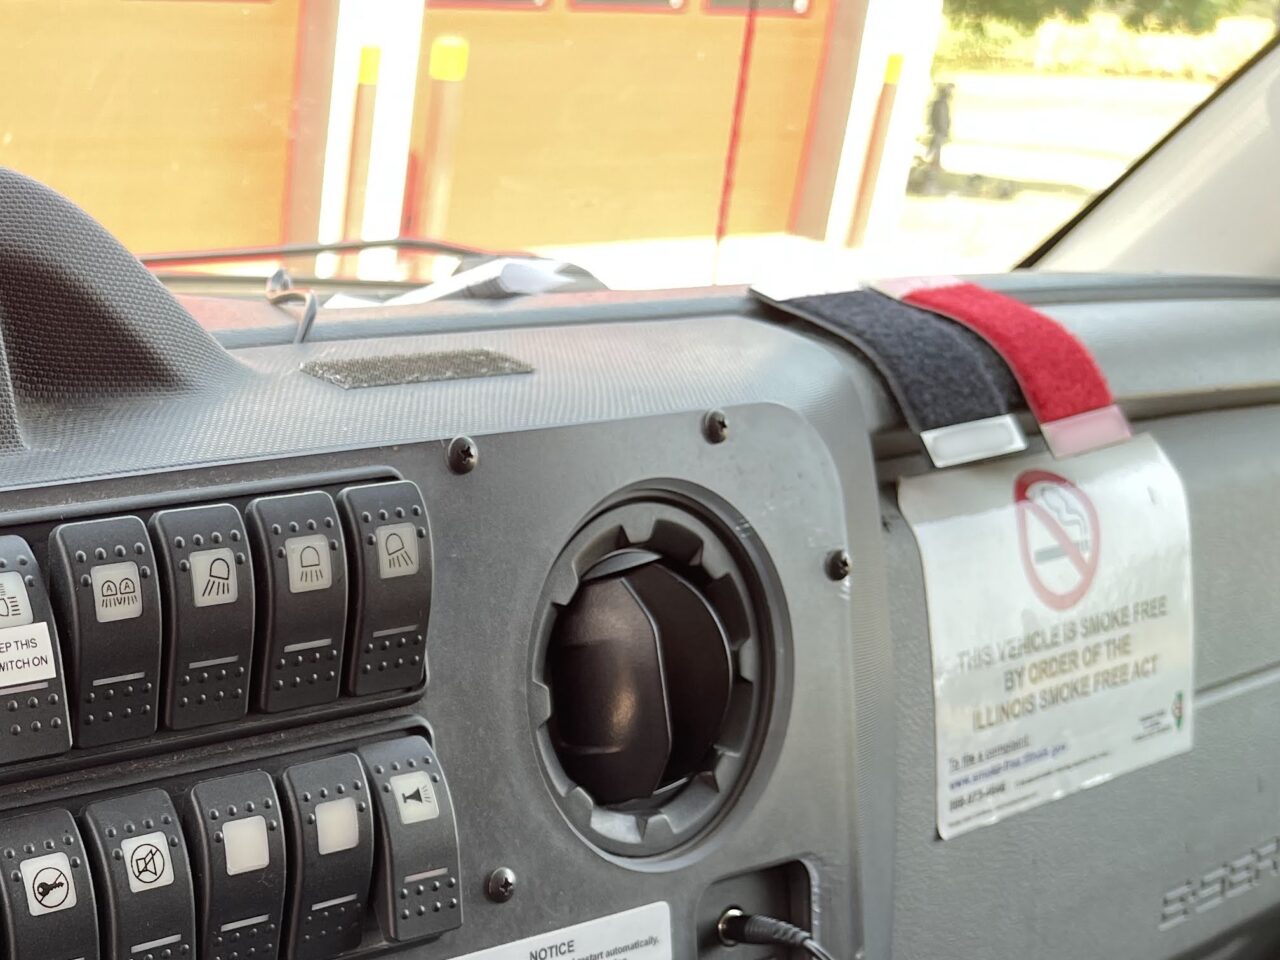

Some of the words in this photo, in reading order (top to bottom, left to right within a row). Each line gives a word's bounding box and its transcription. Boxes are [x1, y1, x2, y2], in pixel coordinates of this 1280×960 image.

[14, 638, 38, 651] THIS
[957, 644, 993, 673] THIS
[996, 626, 1060, 662] VEHICLE
[1063, 621, 1077, 641] IS
[1080, 605, 1130, 638] SMOKE
[1133, 596, 1168, 622] FREE
[32, 655, 49, 667] ON
[1004, 665, 1026, 692] BY
[1028, 649, 1079, 684] ORDER
[1082, 644, 1102, 666] OF
[1103, 634, 1131, 660] THE
[973, 694, 1036, 732] ILLINOIS
[1039, 677, 1090, 710] SMOKE
[1092, 662, 1130, 693] FREE
[1130, 654, 1159, 680] ACT
[605, 935, 660, 958] automatically.
